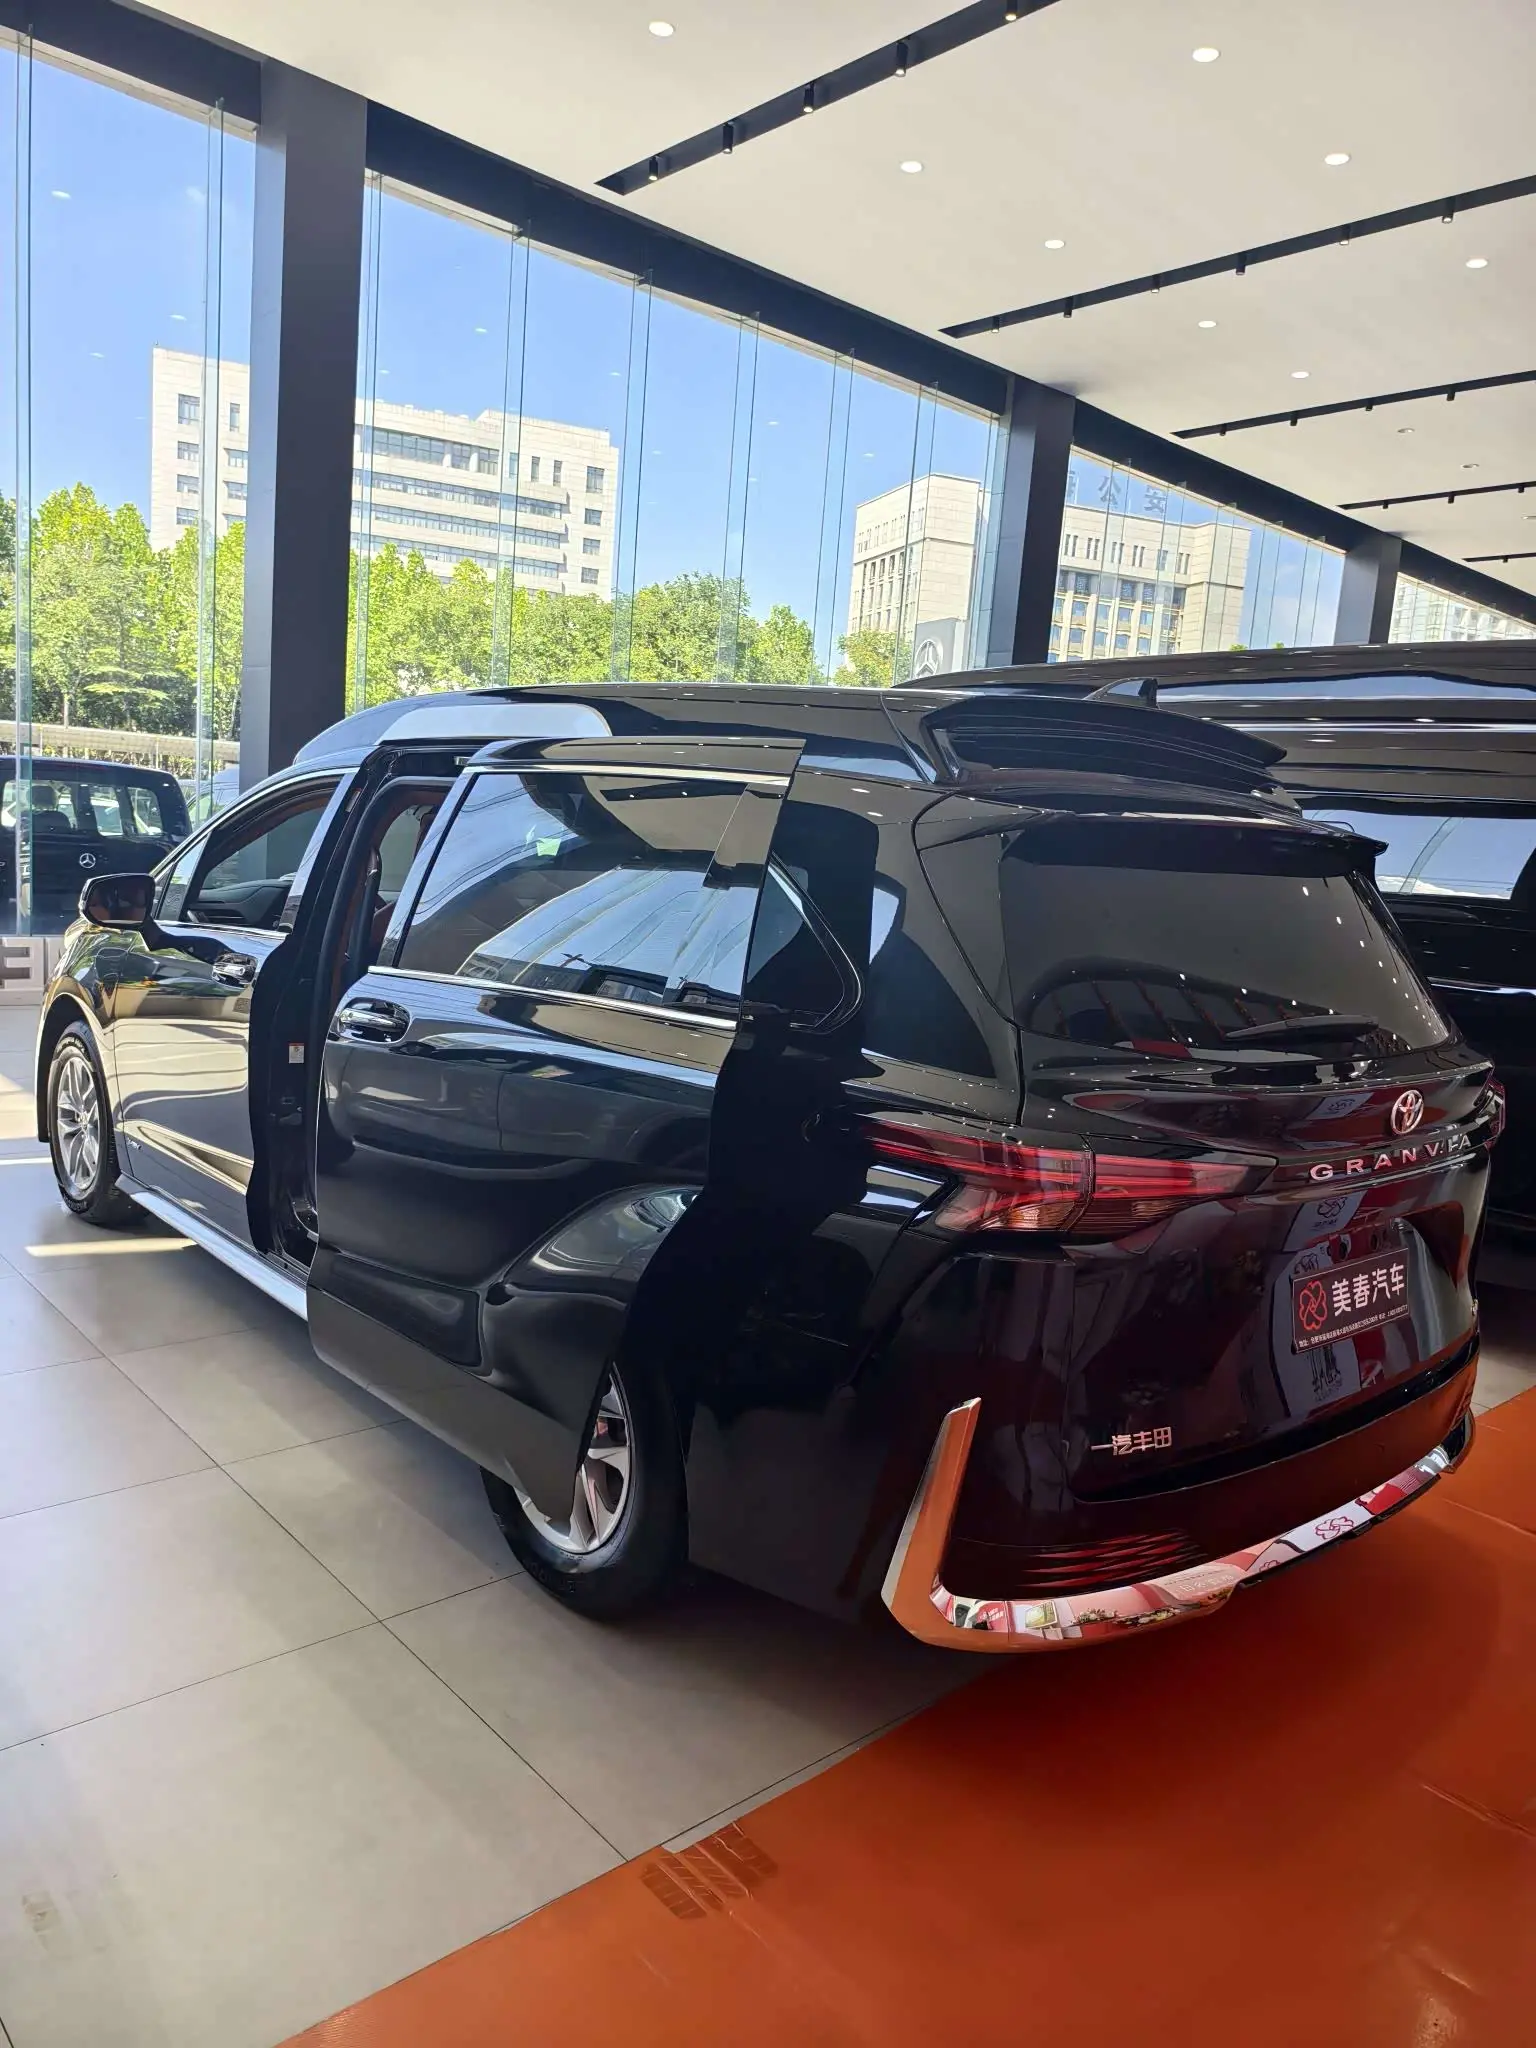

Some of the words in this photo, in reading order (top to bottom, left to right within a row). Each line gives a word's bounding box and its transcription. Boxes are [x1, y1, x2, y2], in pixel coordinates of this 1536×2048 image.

[1310, 1134, 1472, 1181] GRANVIA
[1331, 1262, 1405, 1317] 美春汽车
[1091, 1426, 1172, 1456] 一汽丰田
